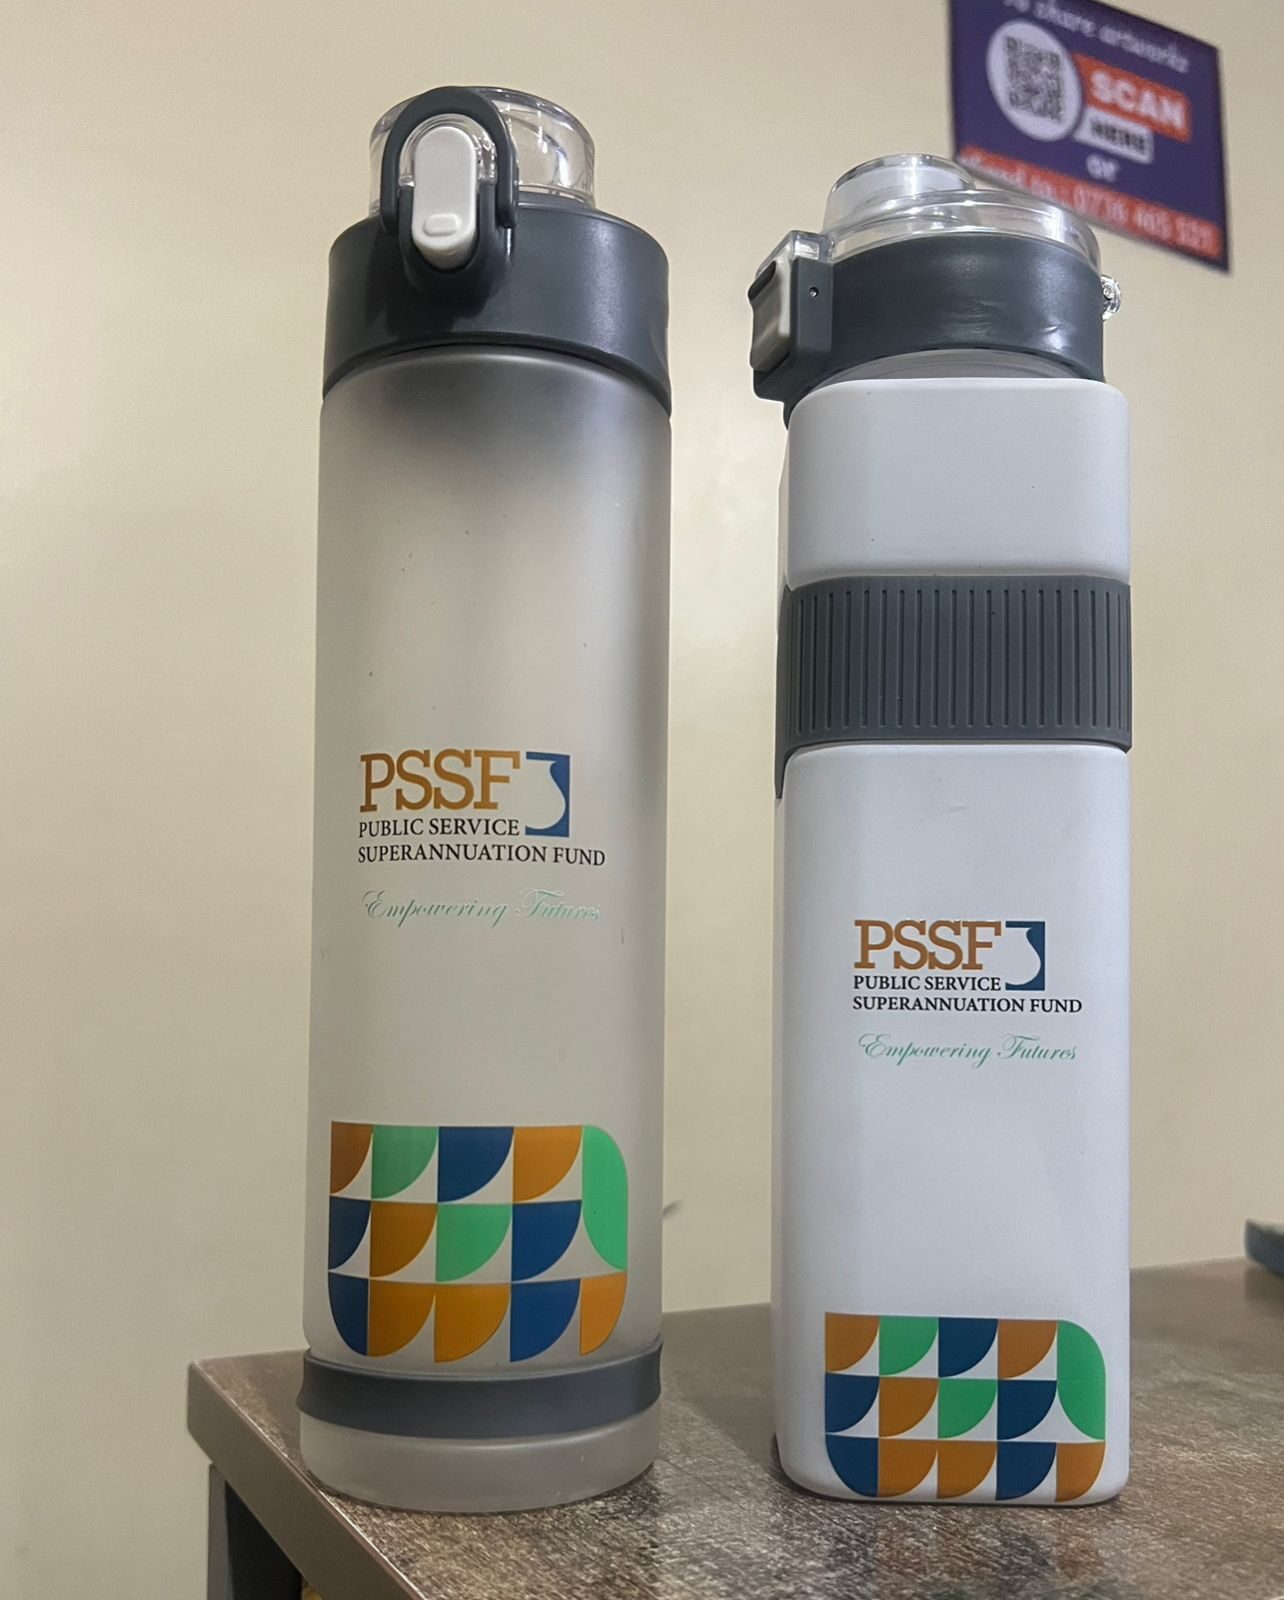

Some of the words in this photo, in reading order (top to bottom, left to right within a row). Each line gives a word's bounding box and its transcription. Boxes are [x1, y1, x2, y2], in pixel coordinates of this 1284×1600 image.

[1089, 68, 1187, 129] SCAN
[359, 748, 521, 813] PSSF
[358, 818, 424, 838] PUBLIC
[428, 817, 520, 836] SERVICE
[357, 843, 547, 863] SUPERANNUATION
[552, 847, 606, 867] FUND
[362, 889, 508, 929] Empowering
[515, 887, 602, 921] Futures
[853, 919, 1002, 971] PSSF
[853, 975, 921, 990] PUBLIC
[924, 976, 1002, 991] SERVICE
[852, 996, 1026, 1012] SUPERANNUATION
[1029, 998, 1083, 1013] FUND
[858, 1032, 992, 1070] Empowering
[997, 1034, 1078, 1061] Futures
